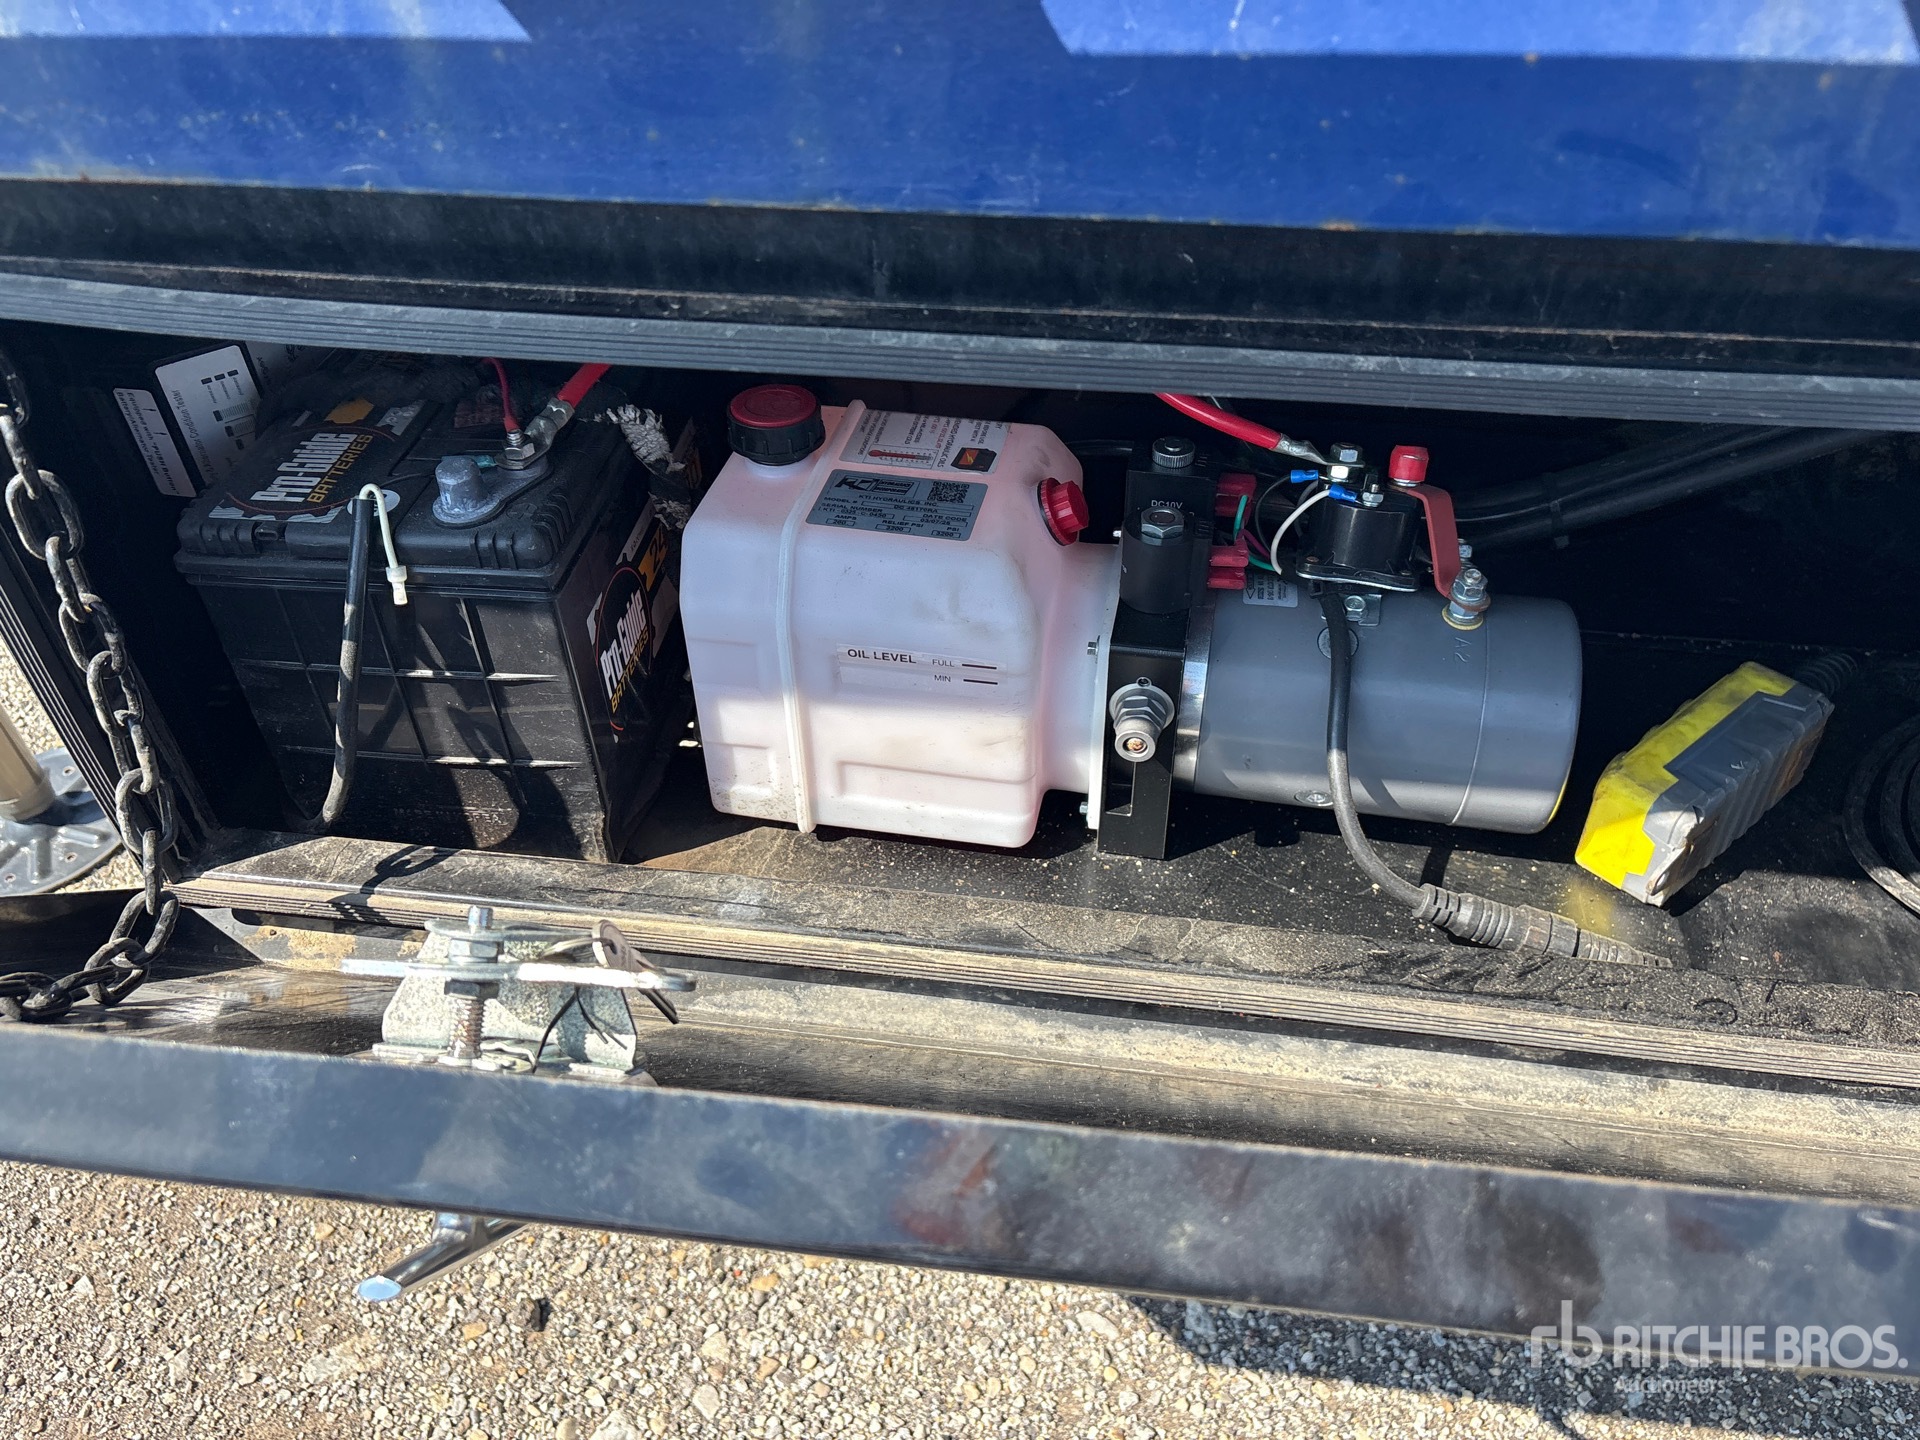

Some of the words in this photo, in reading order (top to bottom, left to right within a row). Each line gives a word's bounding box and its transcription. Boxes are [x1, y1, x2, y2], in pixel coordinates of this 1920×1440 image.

[172, 390, 186, 410] Tester
[127, 392, 147, 426] Equipped
[144, 426, 154, 440] with
[307, 434, 374, 504] BATTERIES
[873, 494, 920, 504] HYDRAULICS
[847, 648, 870, 659] OIL
[873, 651, 916, 664] LEVEL
[932, 658, 955, 668] FULL
[611, 630, 650, 714] BATTERIES
[934, 674, 952, 682] MIN
